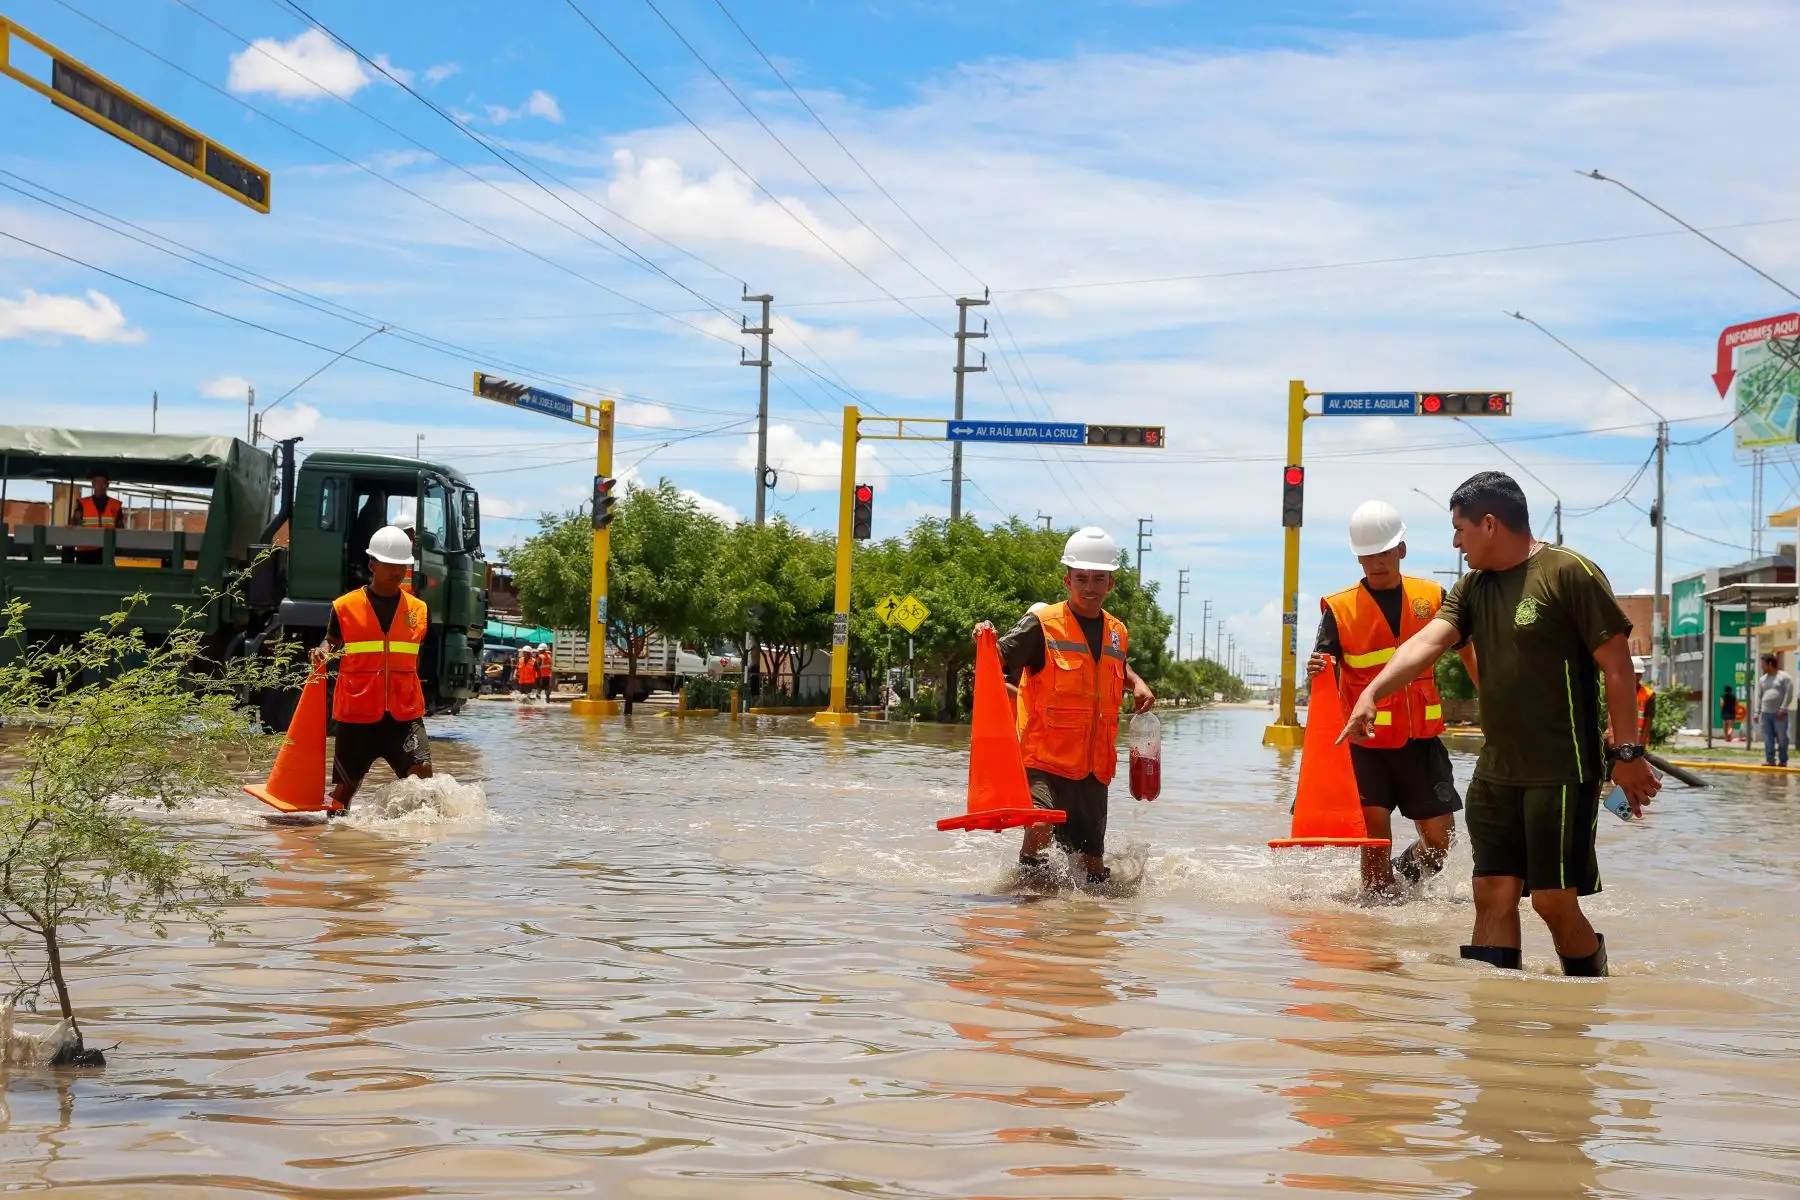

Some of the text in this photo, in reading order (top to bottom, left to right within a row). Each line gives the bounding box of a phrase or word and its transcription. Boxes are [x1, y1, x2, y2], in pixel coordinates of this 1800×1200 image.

[1725, 324, 1773, 346] INFORMES
[1328, 399, 1410, 409] AV. JOSE E. AGUILAR
[1488, 397, 1503, 411] 55
[976, 424, 1079, 439] AV. RAÚL MATA LA CRUZ
